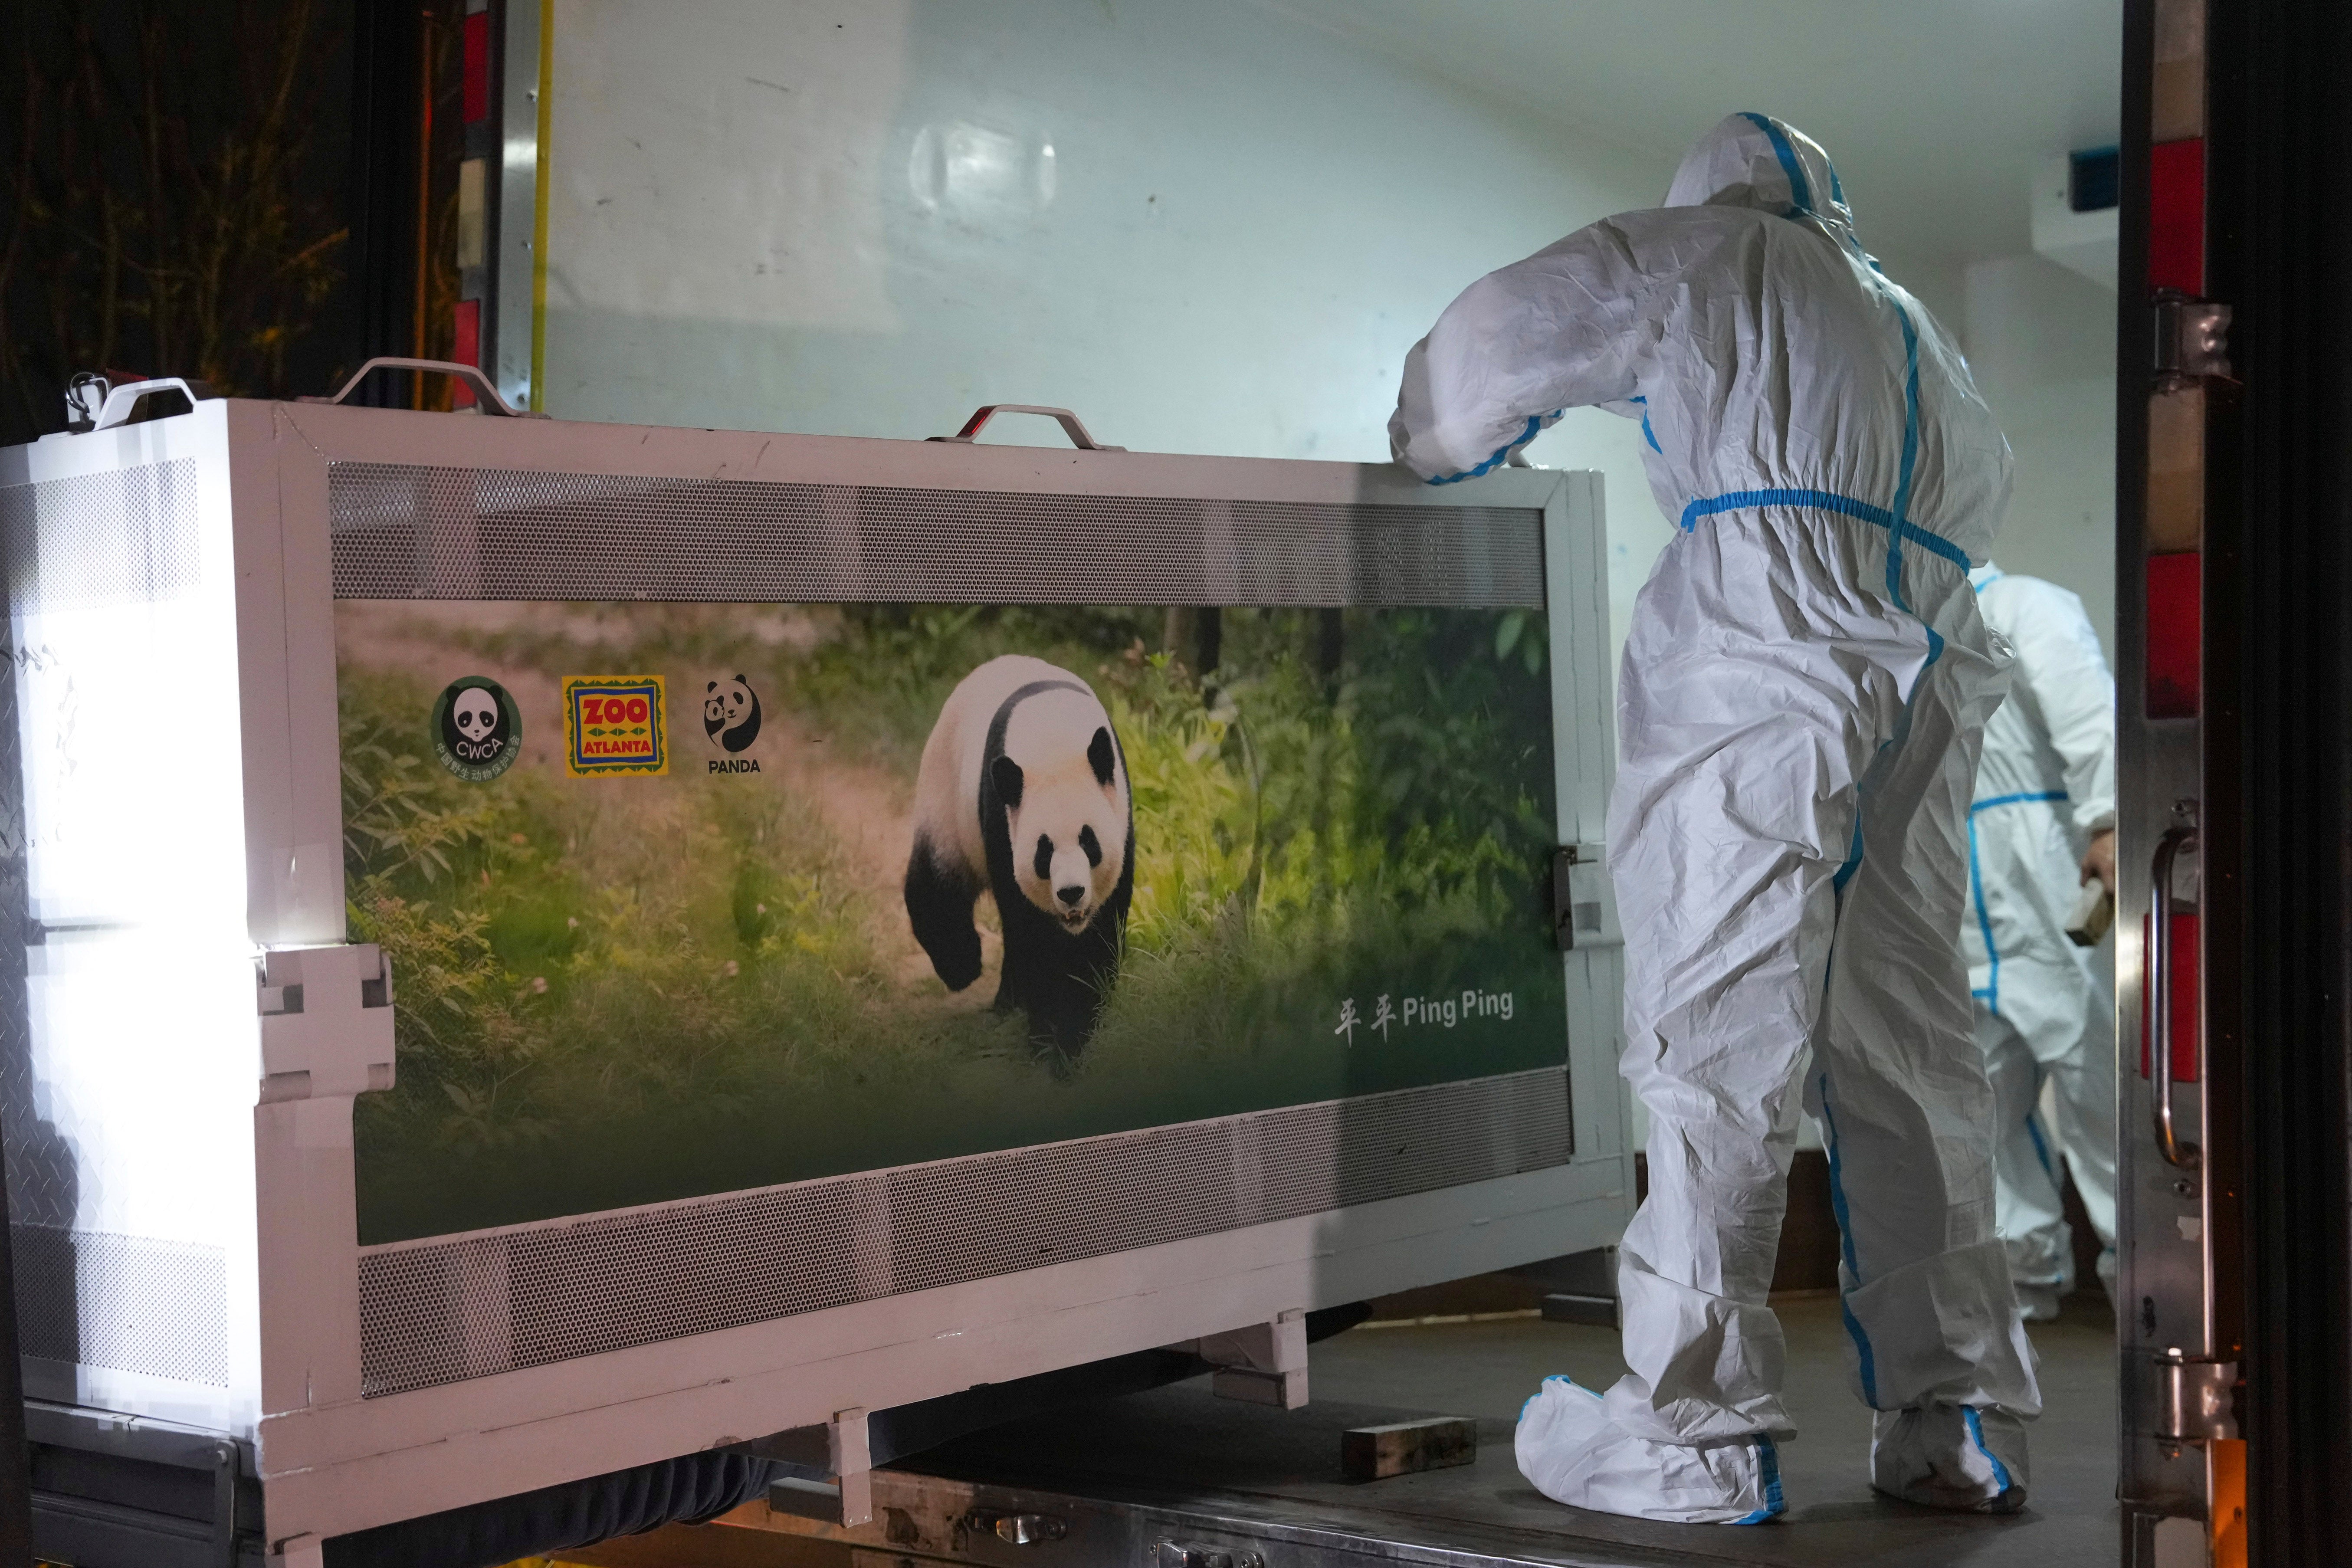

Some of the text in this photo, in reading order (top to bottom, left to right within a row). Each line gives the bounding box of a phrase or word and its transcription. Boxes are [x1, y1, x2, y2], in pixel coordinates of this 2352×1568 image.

[583, 699, 648, 725] ZOO
[456, 738, 504, 759] CWCA
[583, 740, 652, 754] ATLANTA
[708, 758, 761, 774] PANDA
